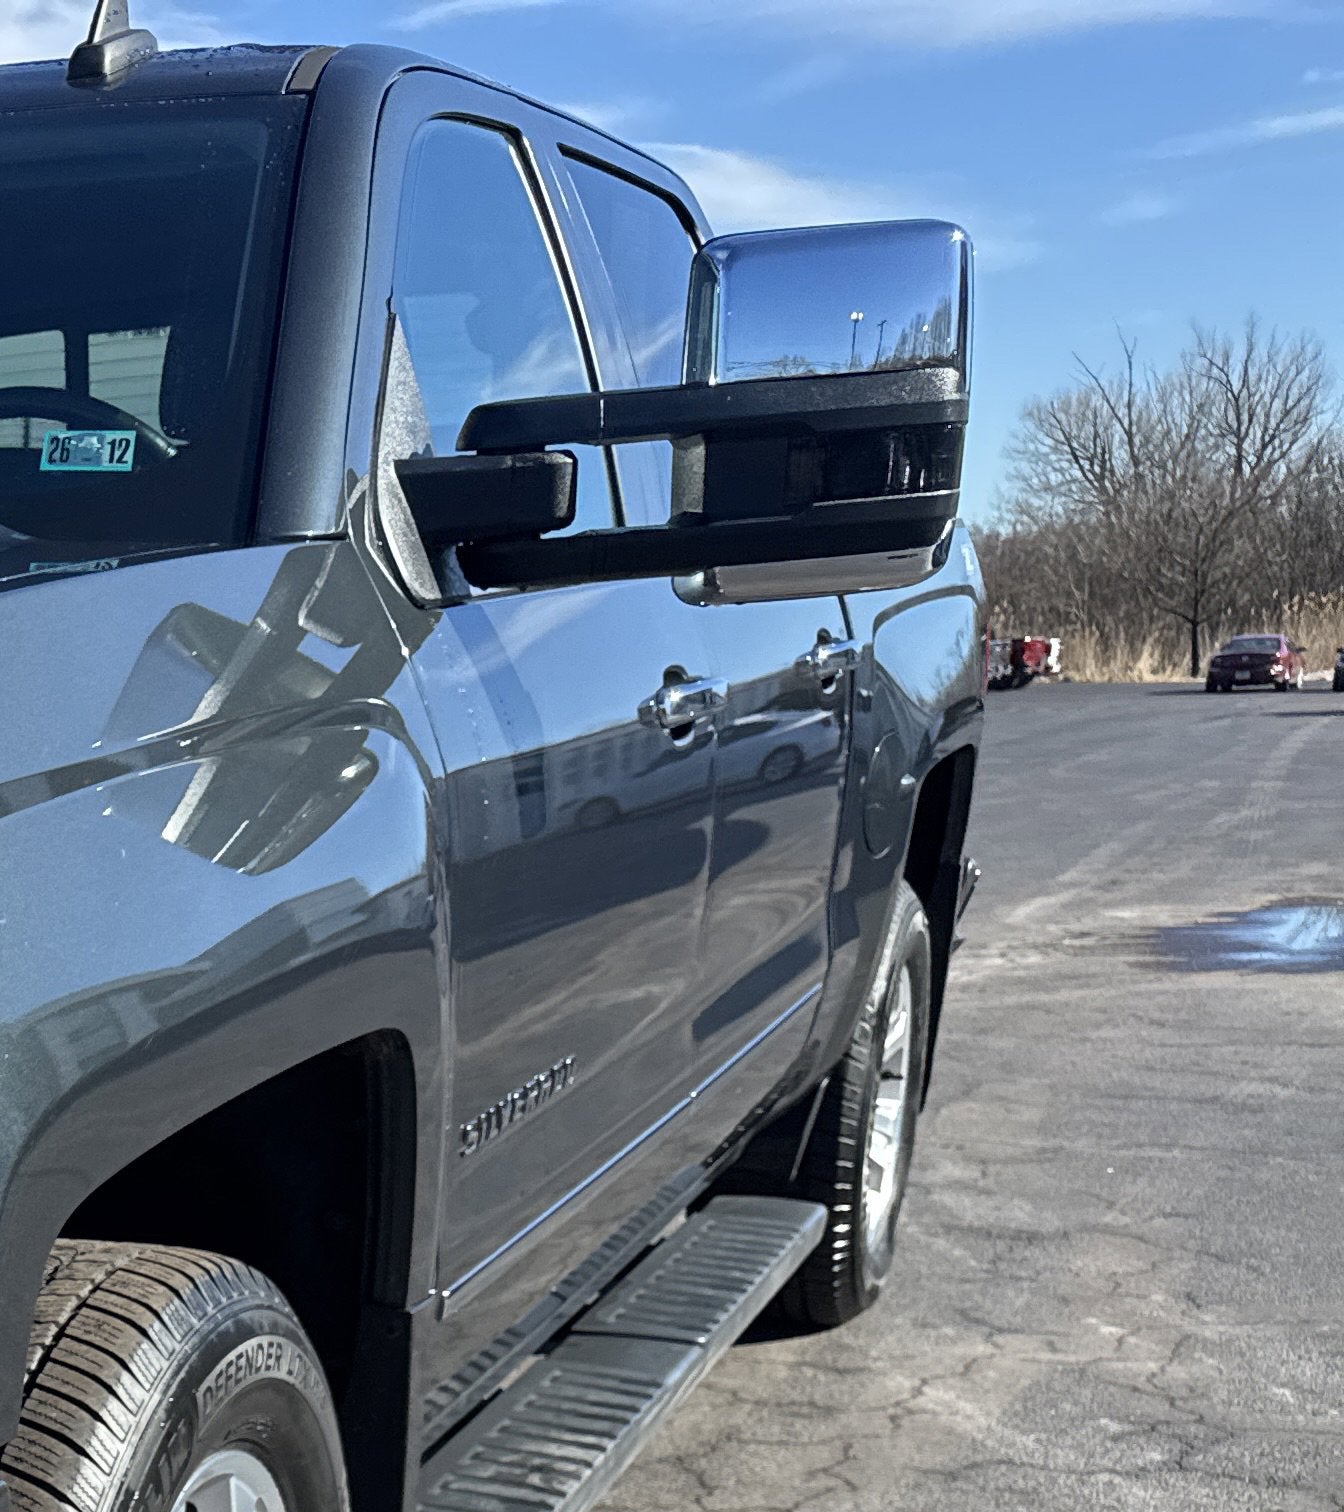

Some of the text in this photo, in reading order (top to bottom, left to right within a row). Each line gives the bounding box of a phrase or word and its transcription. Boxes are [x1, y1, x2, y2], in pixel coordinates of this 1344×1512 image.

[48, 436, 71, 464] 26
[107, 438, 131, 464] 12
[203, 1341, 282, 1415] DEFENDER
